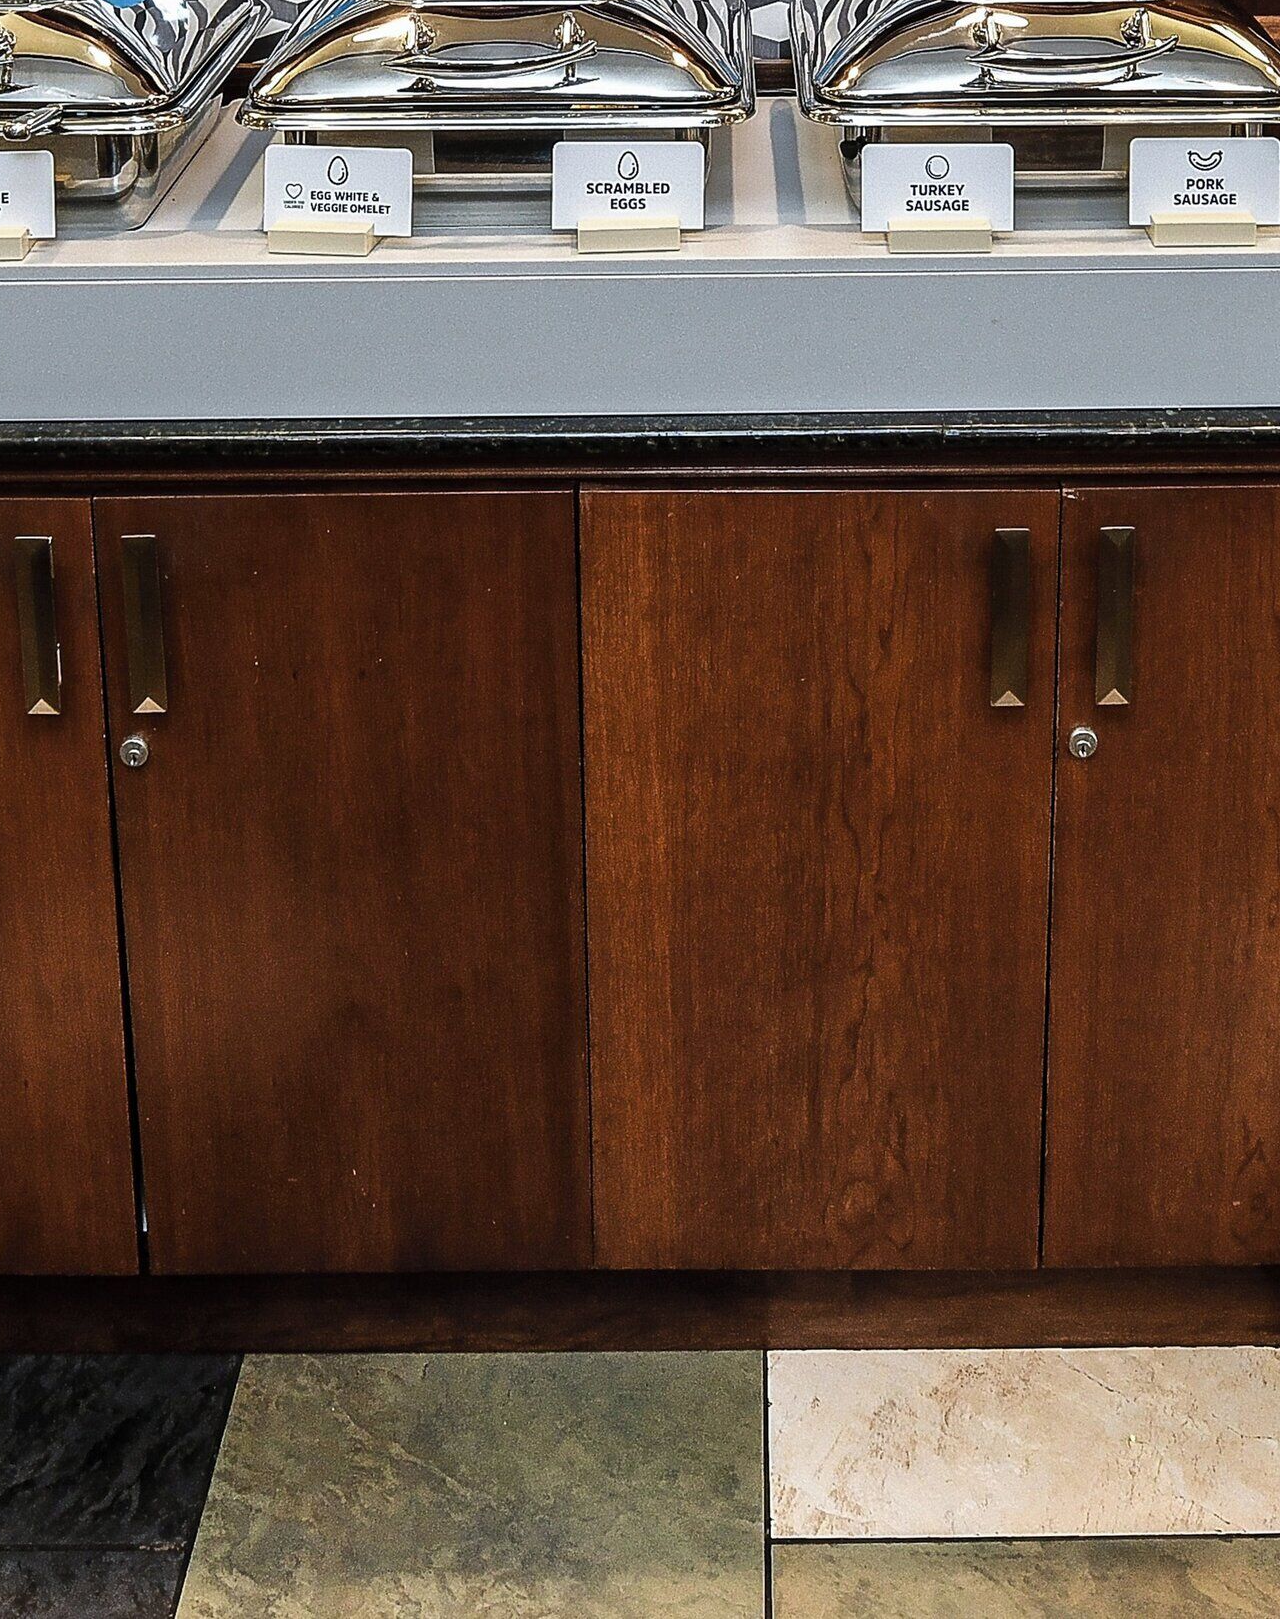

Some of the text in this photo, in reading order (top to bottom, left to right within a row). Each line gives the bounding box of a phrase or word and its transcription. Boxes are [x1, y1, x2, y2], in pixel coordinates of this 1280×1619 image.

[585, 182, 671, 195] SCRAMBLED
[909, 184, 966, 197] TURKEY
[1185, 178, 1225, 190] PORK
[310, 190, 380, 203] EGG WHITE &
[1173, 193, 1238, 206] SAUSAGE
[310, 202, 349, 213] VEGGIE
[350, 203, 392, 215] OMELET
[609, 198, 647, 210] EGGS
[905, 199, 970, 212] SAUSAGE
